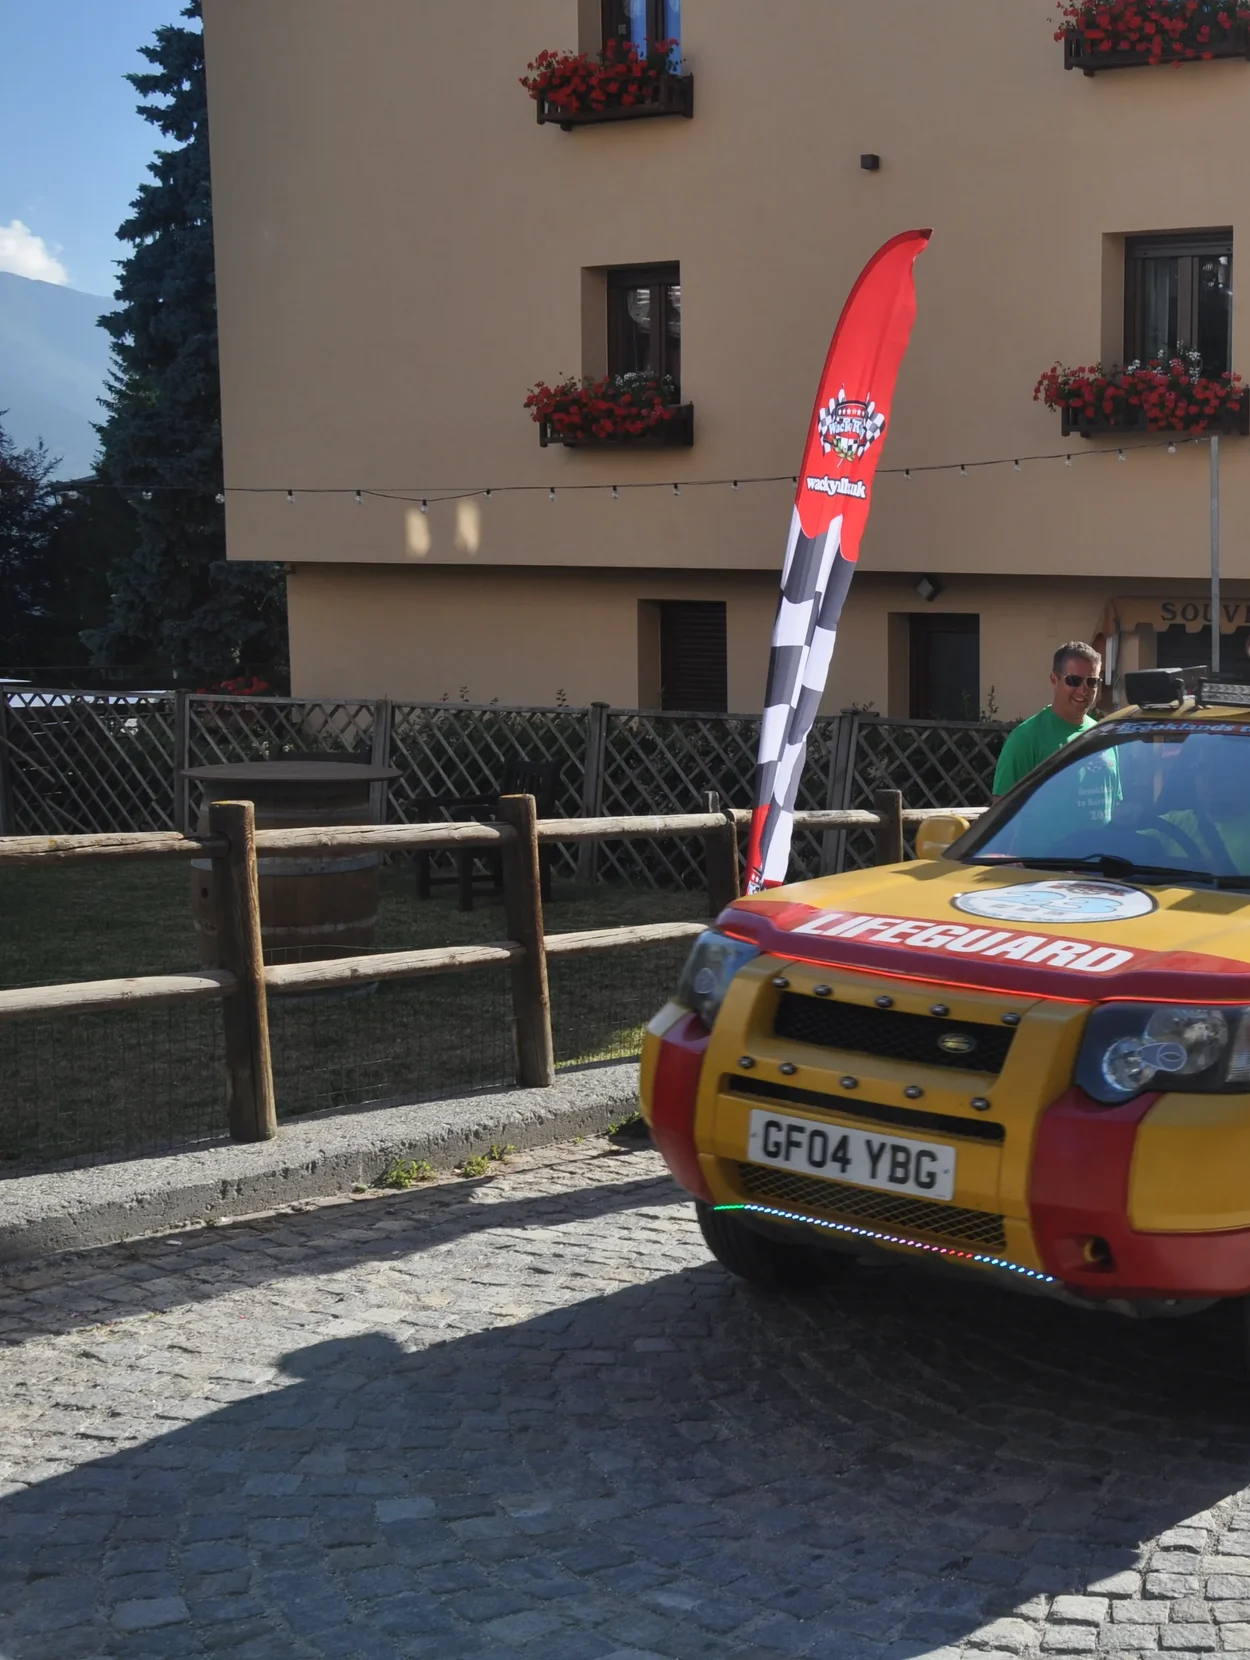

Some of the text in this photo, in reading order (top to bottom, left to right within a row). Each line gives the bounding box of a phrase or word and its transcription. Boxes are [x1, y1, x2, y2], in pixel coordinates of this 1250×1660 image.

[1117, 722, 1235, 734] Brooklands
[984, 890, 1123, 914] 23
[790, 911, 1134, 972] LIFEGUARD
[762, 1119, 939, 1190] GF04 YBG
